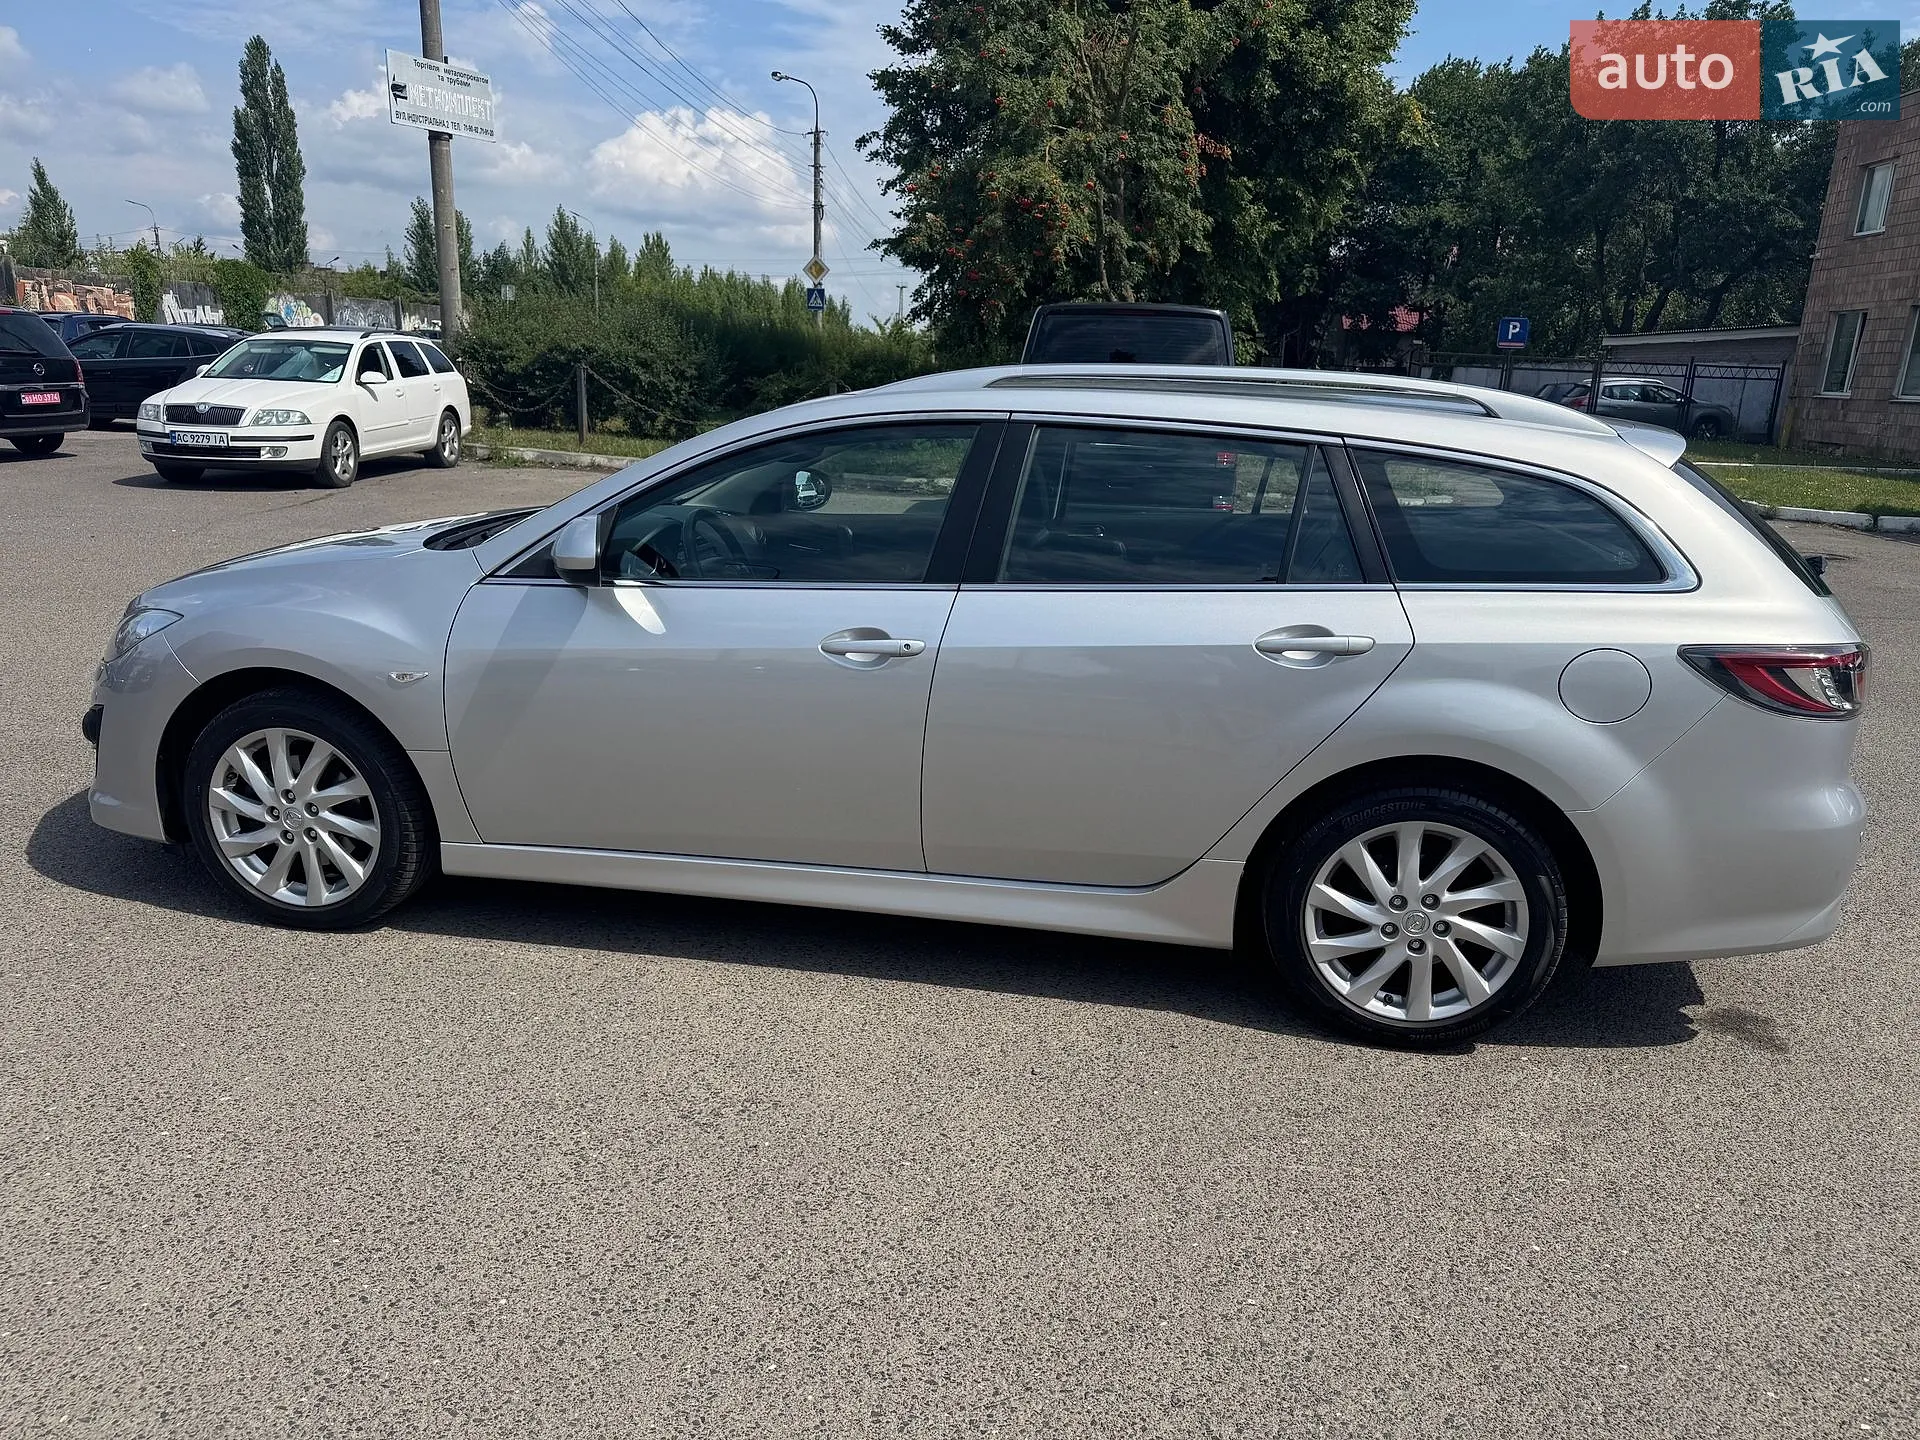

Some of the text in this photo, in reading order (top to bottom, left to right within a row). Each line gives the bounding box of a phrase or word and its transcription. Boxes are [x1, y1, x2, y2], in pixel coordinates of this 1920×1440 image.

[1508, 321, 1521, 340] P
[177, 433, 226, 445] AC 9279 IA
